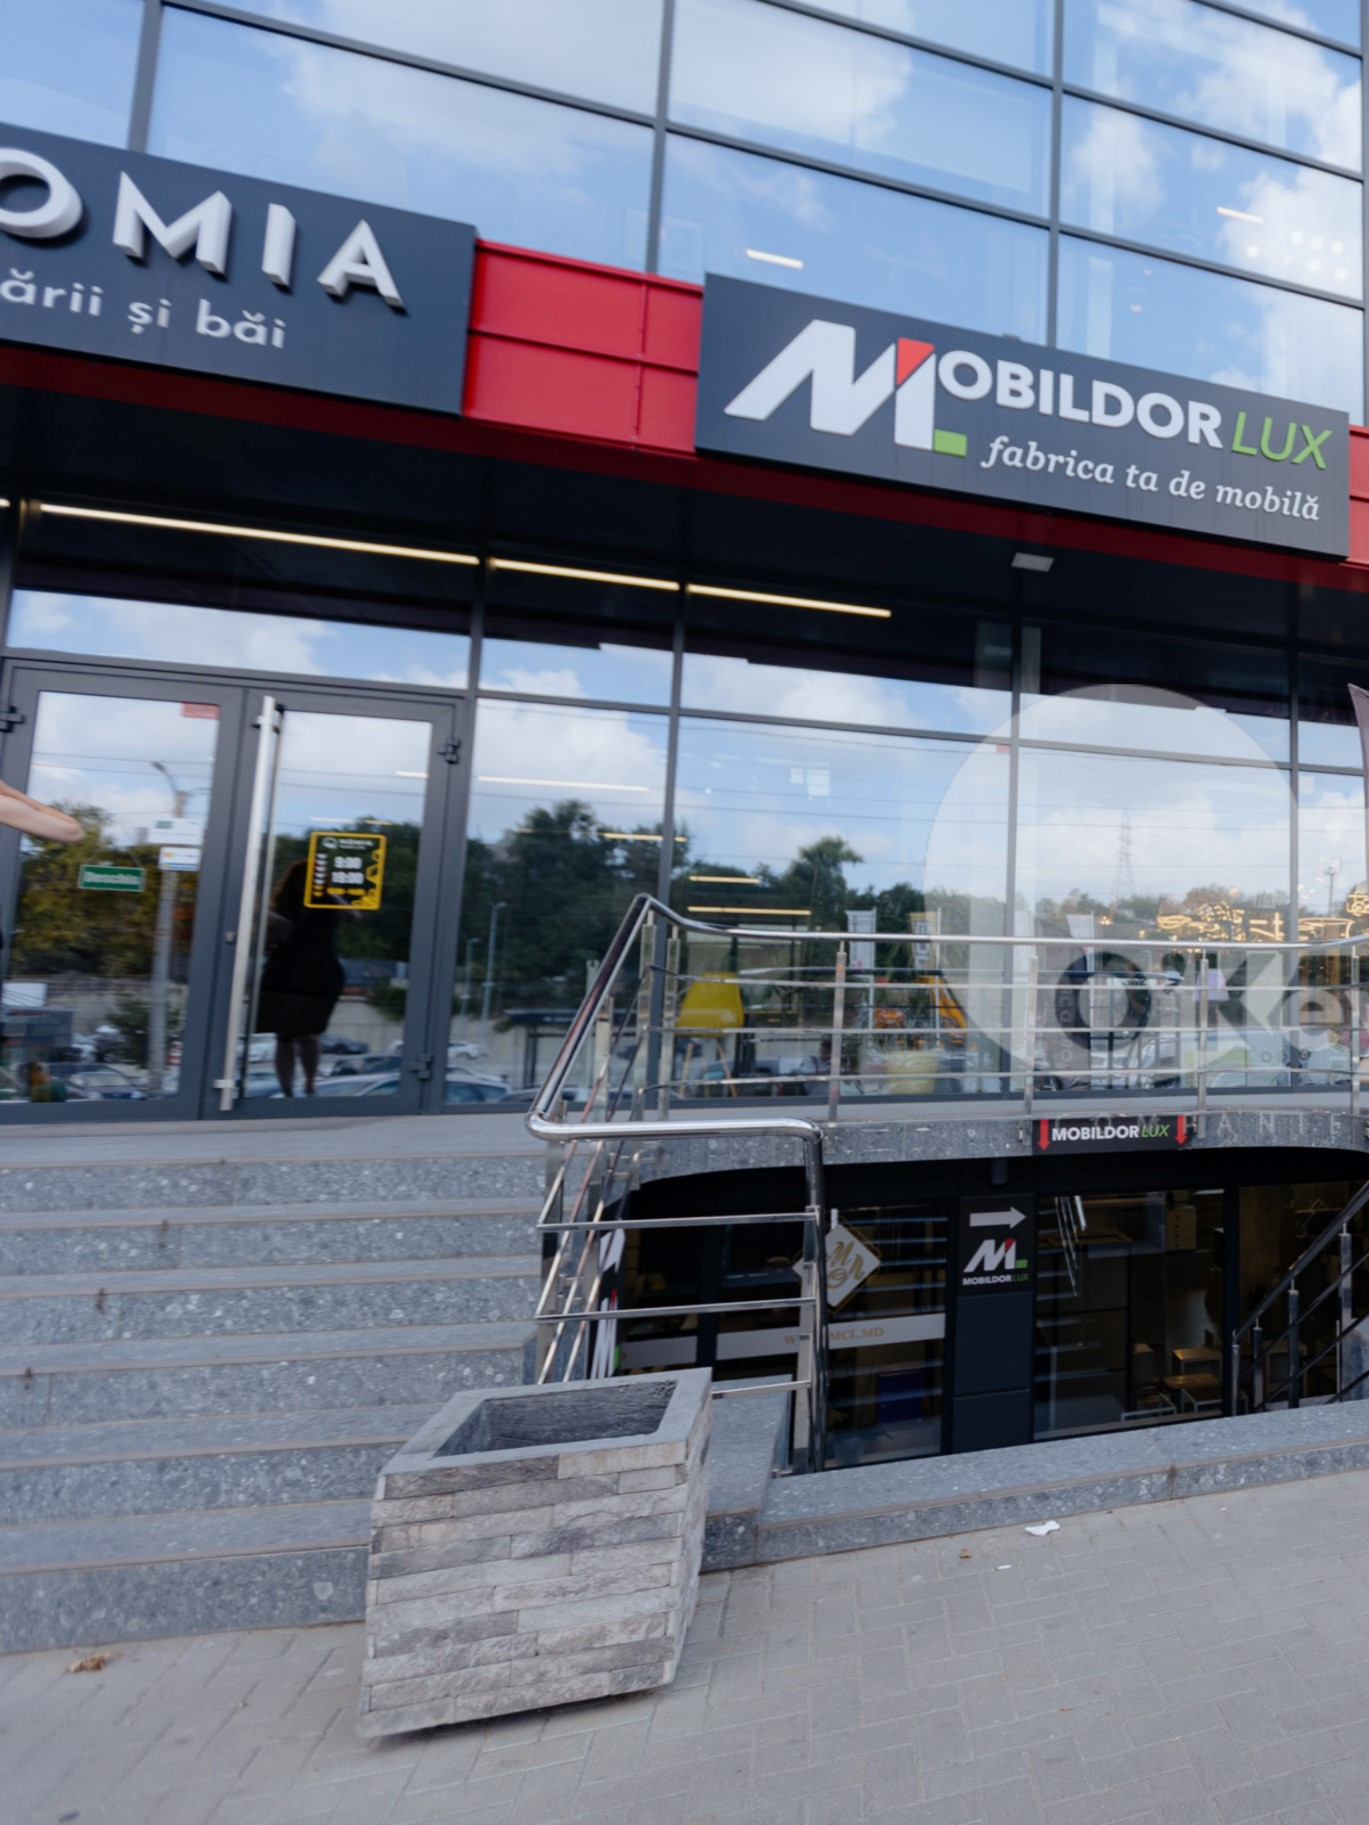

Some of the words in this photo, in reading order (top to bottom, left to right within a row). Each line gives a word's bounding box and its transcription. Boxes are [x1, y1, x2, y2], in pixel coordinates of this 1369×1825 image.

[127, 298, 171, 334] și
[195, 298, 286, 349] băi
[981, 435, 1115, 485] fabrica
[1126, 464, 1160, 493] ta
[1168, 470, 1207, 501] de
[1215, 483, 1320, 521] mobilă
